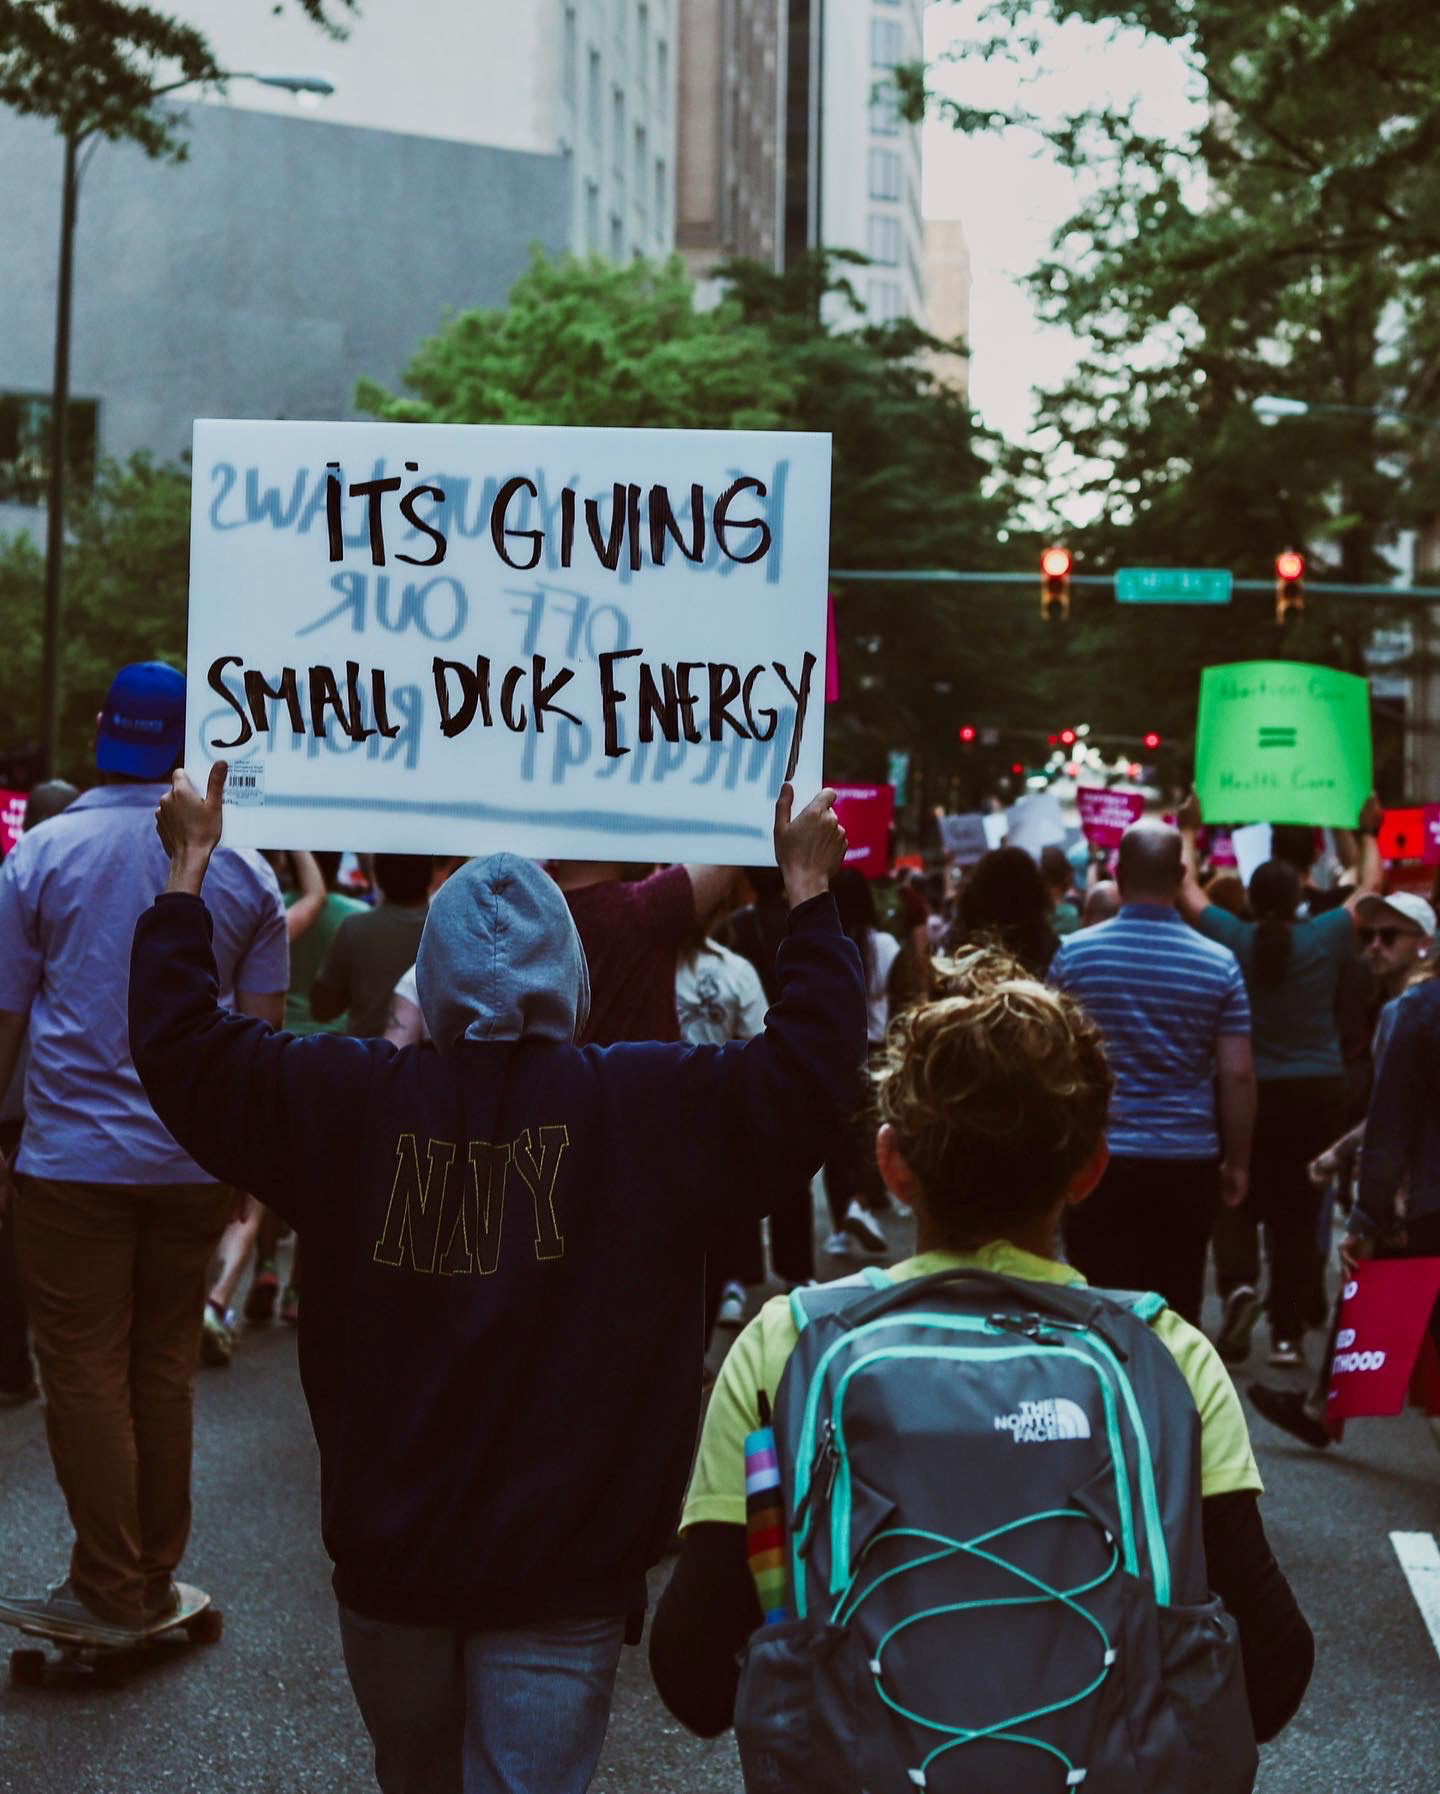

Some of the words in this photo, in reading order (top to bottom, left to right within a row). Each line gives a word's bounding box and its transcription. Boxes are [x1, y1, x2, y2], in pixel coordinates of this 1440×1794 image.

[491, 476, 772, 571] GIVING
[207, 656, 401, 748] SMALL
[432, 654, 583, 739] DICK
[598, 648, 817, 782] ENERGY
[1018, 1399, 1056, 1416] THE
[994, 1409, 1057, 1431] NORTH
[1013, 1425, 1057, 1443] FACE
